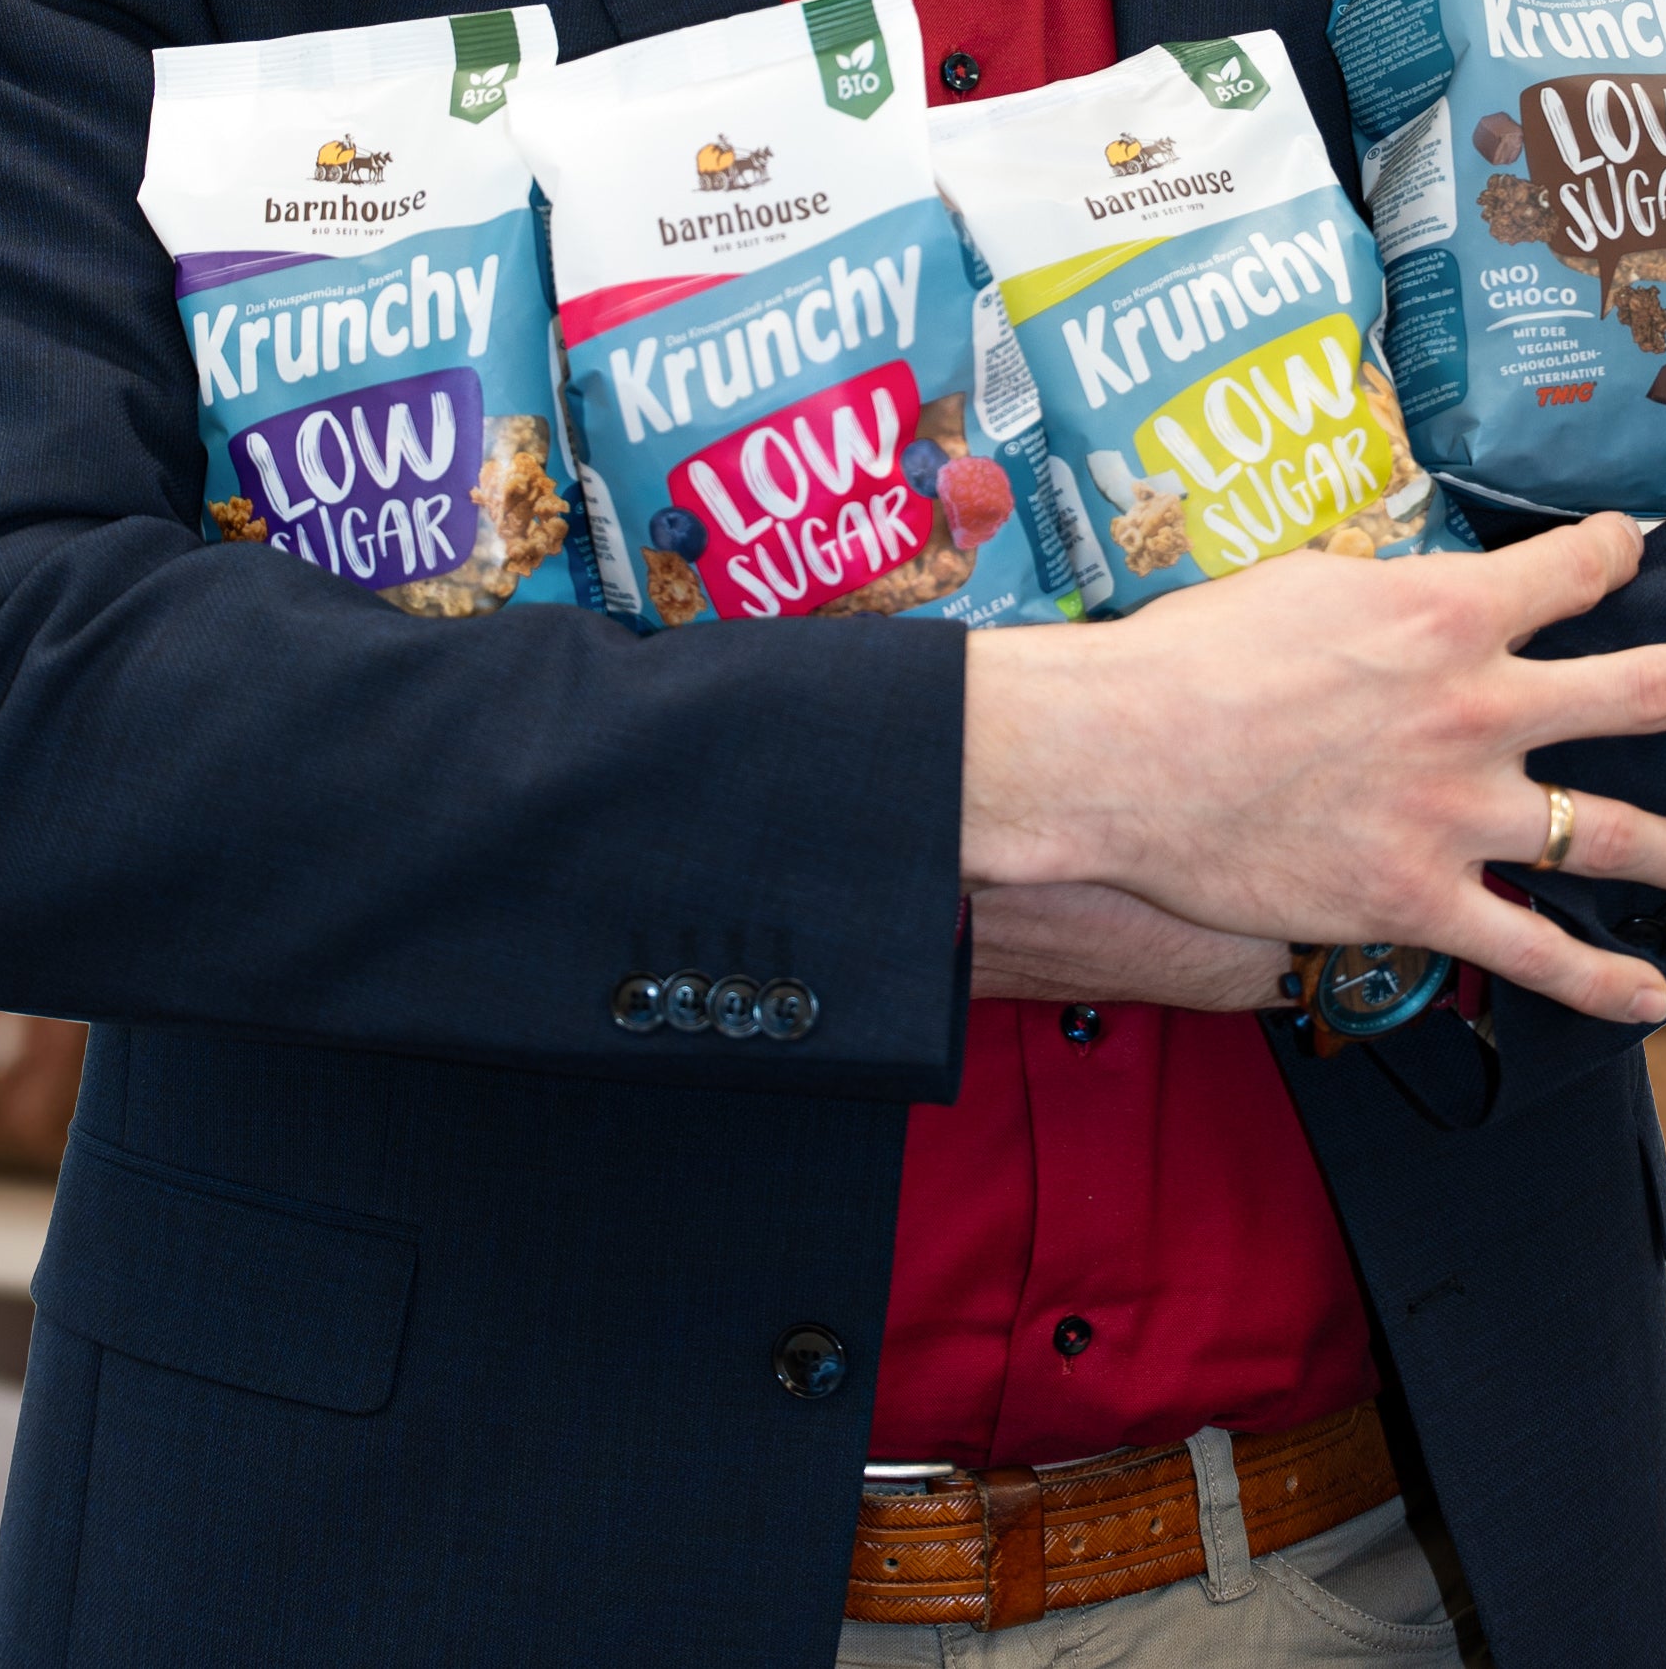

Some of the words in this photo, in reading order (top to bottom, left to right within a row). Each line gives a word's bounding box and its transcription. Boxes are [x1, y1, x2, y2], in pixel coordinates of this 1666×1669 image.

[460, 87, 503, 108] BIO
[837, 72, 880, 99] BIO
[1215, 79, 1255, 103] BIO
[265, 190, 426, 223] barnhouse
[1085, 170, 1234, 221] barnhouse
[335, 227, 360, 236] SEIT
[658, 192, 830, 246] barnhouse
[1112, 293, 1133, 312] Das
[1132, 262, 1197, 300] Knuspermüsli
[1197, 258, 1215, 270] aus
[1213, 245, 1247, 265] Bayern
[1480, 263, 1540, 291] (NO)
[245, 303, 266, 316] Das
[268, 286, 345, 311] Knuspermüsli
[346, 283, 366, 296] aus
[1061, 219, 1353, 410] Krunchy
[1488, 287, 1577, 309] CHOCO
[193, 253, 501, 407] Krunchy
[609, 245, 922, 443] Krunchy
[1513, 327, 1538, 339] MIT
[1540, 326, 1566, 337] DER
[1500, 349, 1602, 376] SCHOKOLADEN-
[1517, 339, 1579, 355] VEGANEN
[1523, 366, 1606, 386] ALTERNATIVE
[1153, 335, 1358, 494] LOW
[246, 391, 456, 523] LOW
[687, 386, 901, 547] LOW
[1203, 427, 1380, 568] SUGAR
[725, 484, 919, 619] SUGAR
[942, 594, 971, 618] MIT
